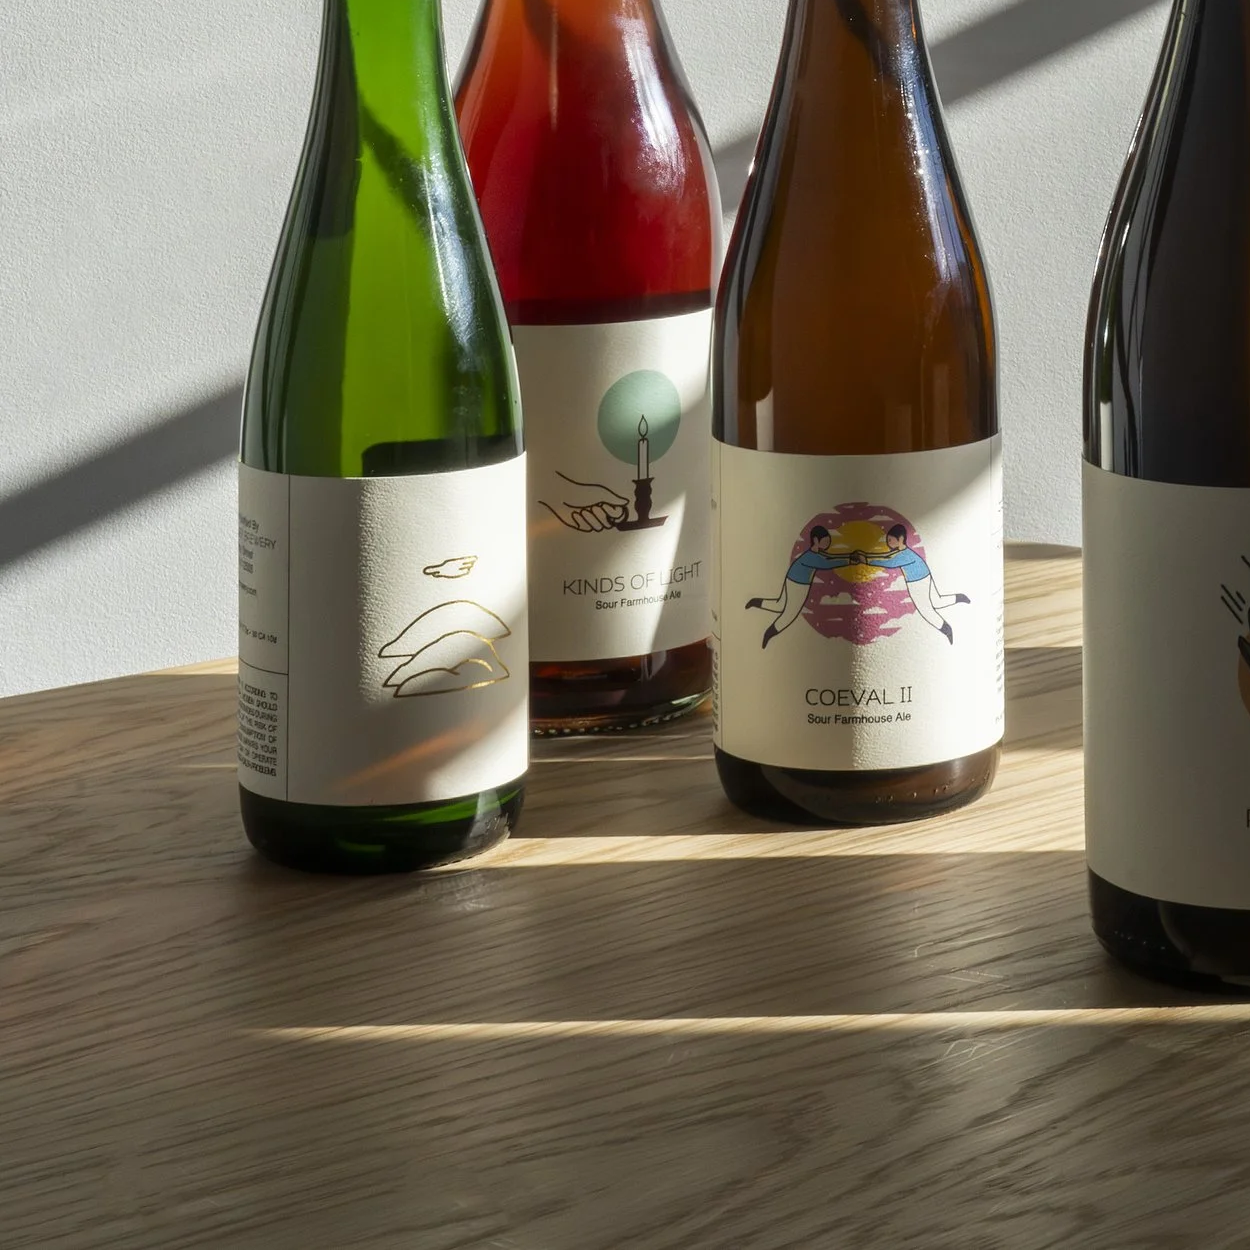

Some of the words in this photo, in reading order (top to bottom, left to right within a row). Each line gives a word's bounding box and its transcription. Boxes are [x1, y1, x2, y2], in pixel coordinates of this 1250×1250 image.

[563, 575, 626, 595] KINDS
[630, 572, 655, 590] OF
[660, 560, 702, 586] LIGHT
[595, 599, 619, 611] Sour
[620, 593, 669, 608] Farmhouse
[669, 590, 682, 600] Ale
[805, 688, 895, 707] COEVAL
[900, 686, 912, 703] II
[807, 713, 832, 725] Sour
[834, 714, 893, 725] Farmhouse
[895, 711, 912, 722] Ale
